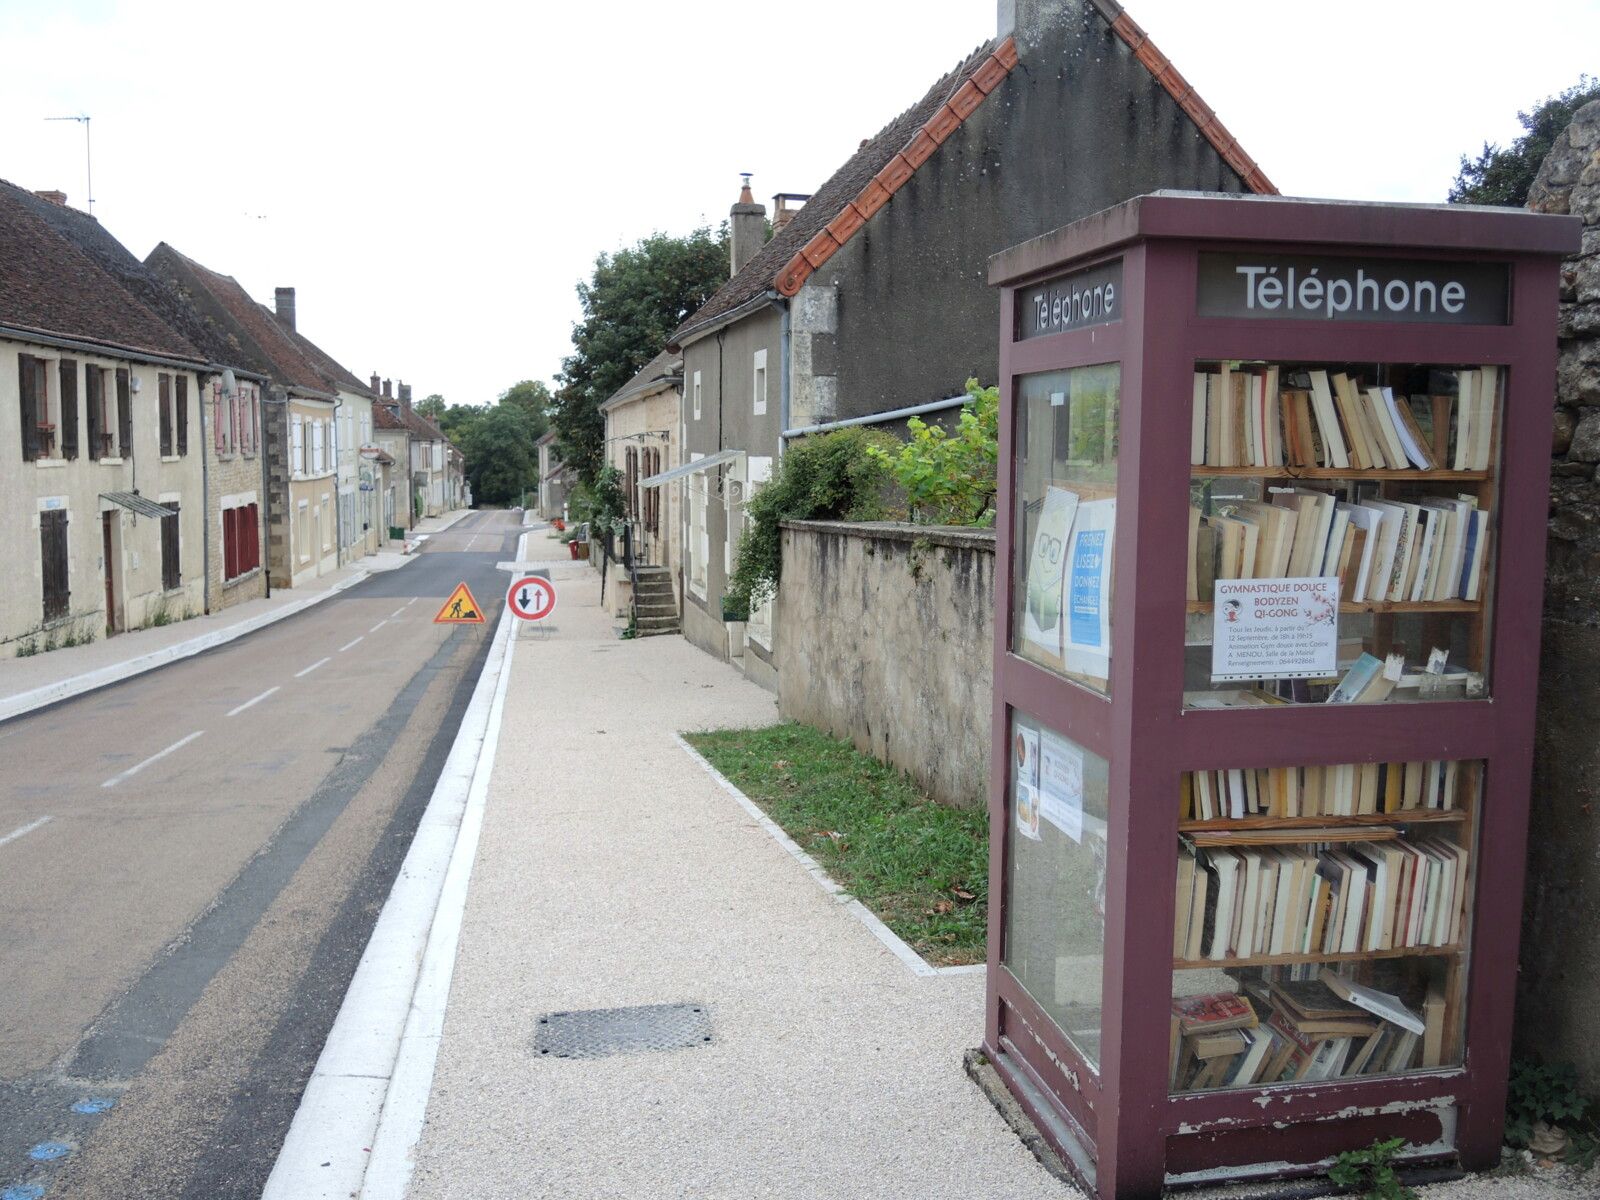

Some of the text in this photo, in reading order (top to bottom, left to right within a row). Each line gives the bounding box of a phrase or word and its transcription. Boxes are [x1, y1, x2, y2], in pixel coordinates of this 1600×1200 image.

[1236, 265, 1466, 319] Téléphone
[1033, 283, 1114, 332] Téléphone
[1220, 583, 1327, 594] GYMNASTIQUE DOUCE
[1254, 597, 1299, 606] BODYZEN
[1254, 609, 1298, 619] QI-GONG
